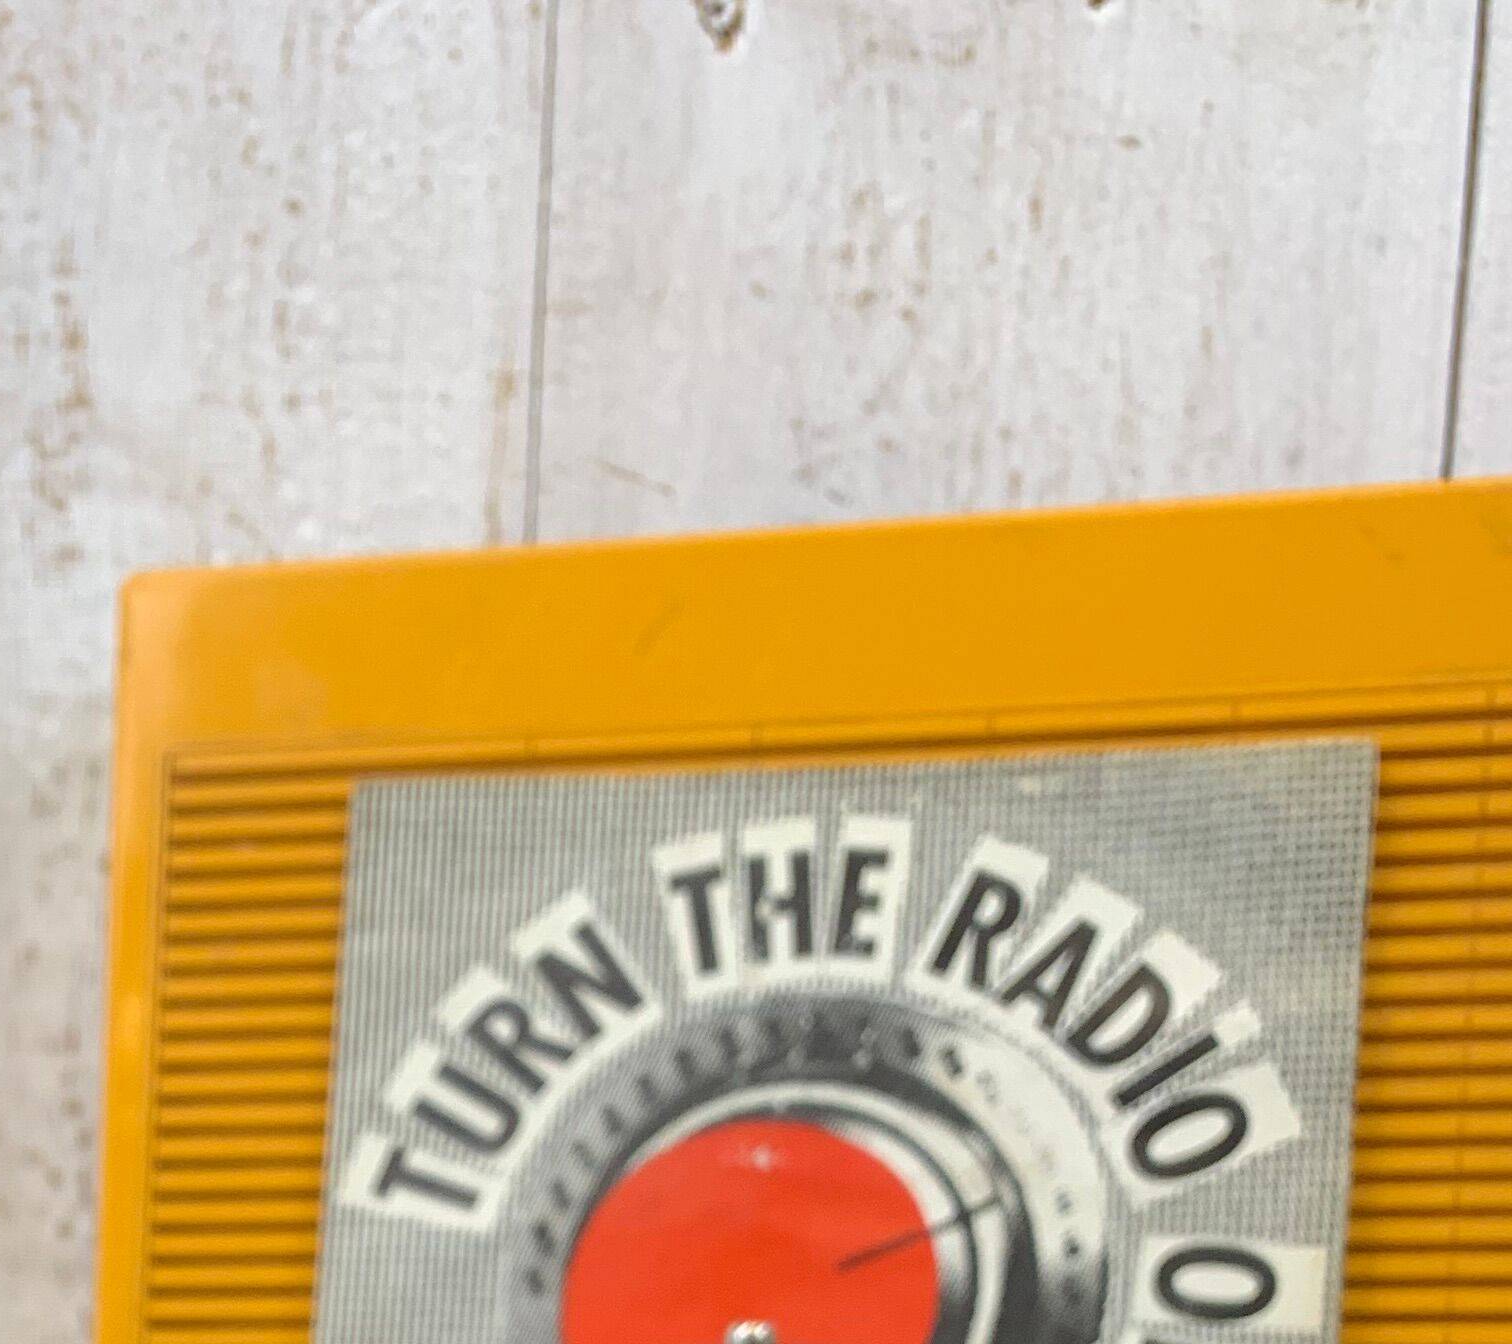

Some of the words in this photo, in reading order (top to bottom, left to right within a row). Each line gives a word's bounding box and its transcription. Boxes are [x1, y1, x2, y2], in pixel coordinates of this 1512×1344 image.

[373, 916, 645, 1222] TURN
[667, 844, 890, 979] THE
[928, 866, 1250, 1182] RADIO
